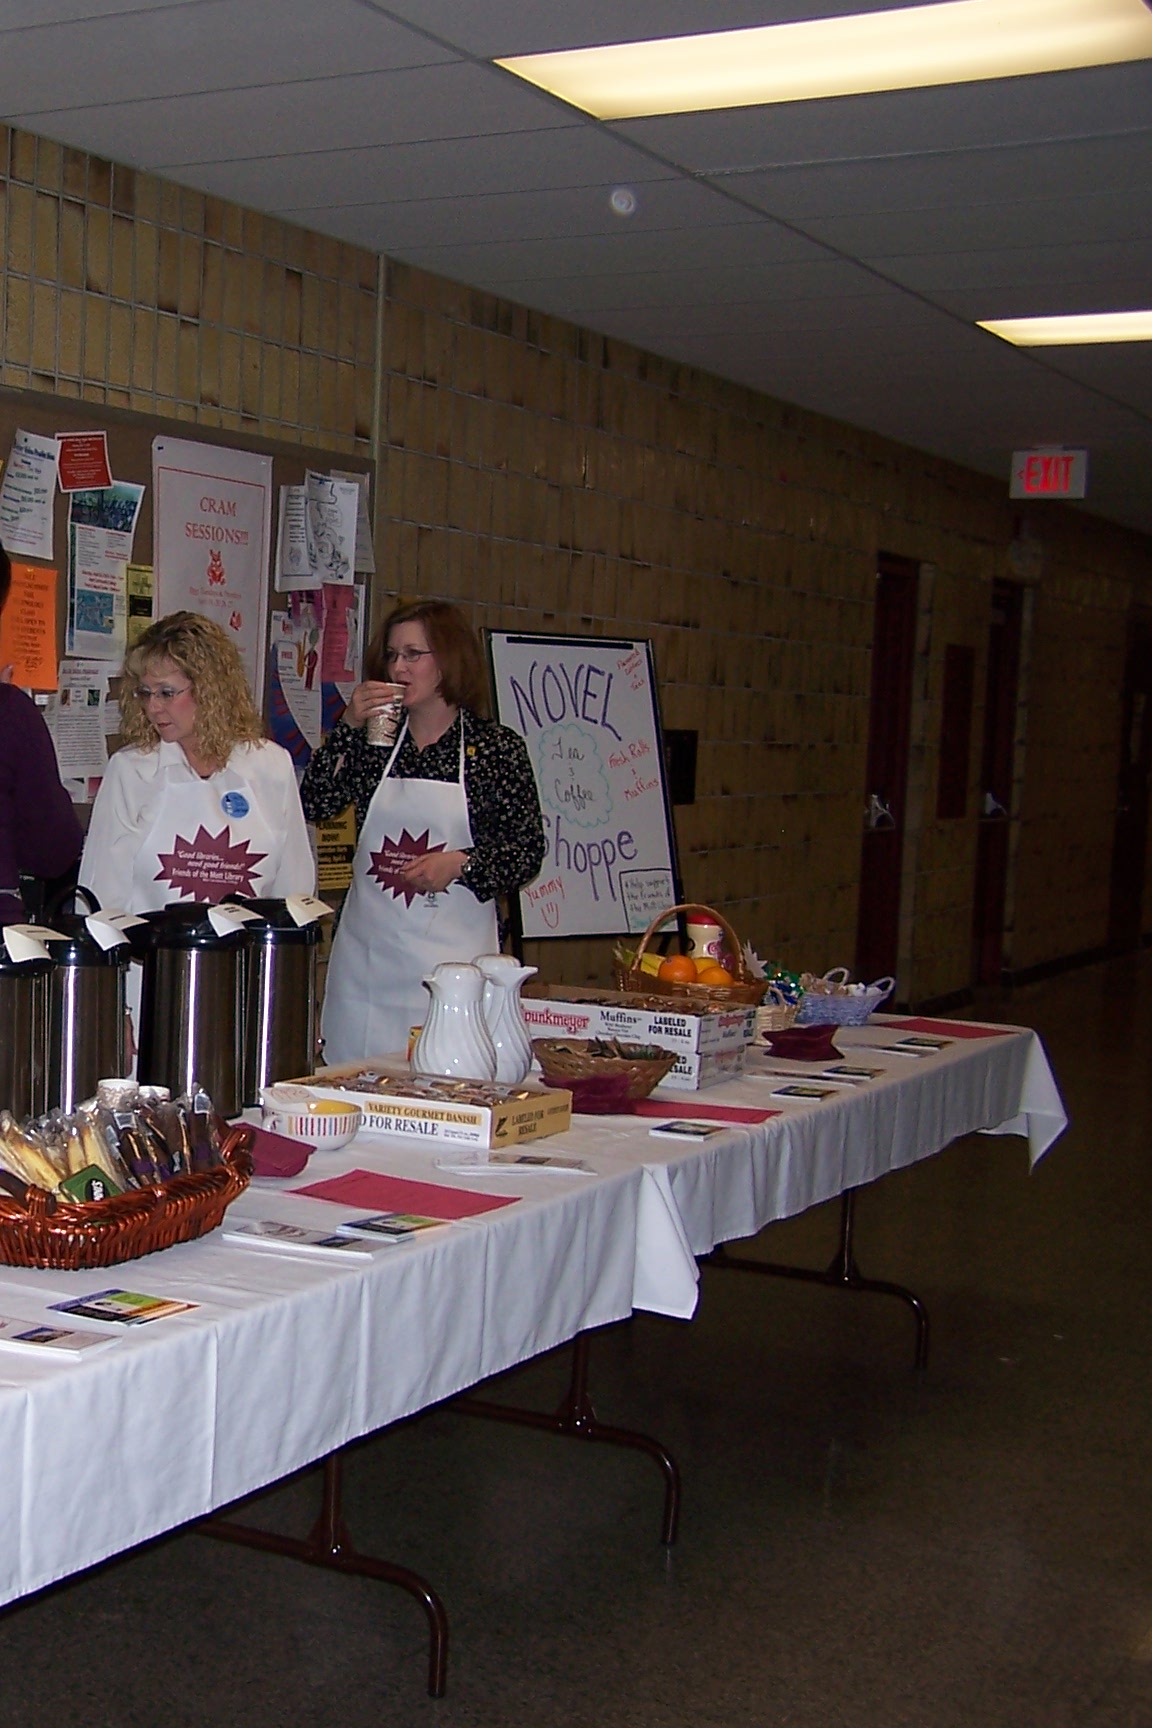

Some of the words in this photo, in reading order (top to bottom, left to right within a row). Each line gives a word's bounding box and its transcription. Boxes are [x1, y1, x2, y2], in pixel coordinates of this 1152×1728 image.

[1024, 455, 1074, 493] EXIT
[199, 496, 237, 517] CRAM
[509, 660, 622, 742] NOVEL
[554, 779, 597, 813] Coffee
[172, 867, 191, 877] Friends
[192, 868, 199, 878] of
[199, 869, 209, 878] the
[209, 870, 224, 880] Mott
[224, 870, 244, 883] Library
[203, 862, 219, 870] good
[524, 875, 565, 907] Yummy
[520, 1006, 590, 1035] punkmeyer
[599, 1010, 638, 1025] Muffins
[653, 1015, 687, 1028] LABELED
[648, 1024, 662, 1035] FOR
[663, 1026, 692, 1038] RESALE
[669, 1064, 693, 1076] ESALE
[366, 1102, 404, 1116] VARIETY
[404, 1107, 444, 1121] GOURMET
[445, 1112, 478, 1126] DANISH
[368, 1117, 394, 1131] FOR
[394, 1119, 439, 1136] RESALE
